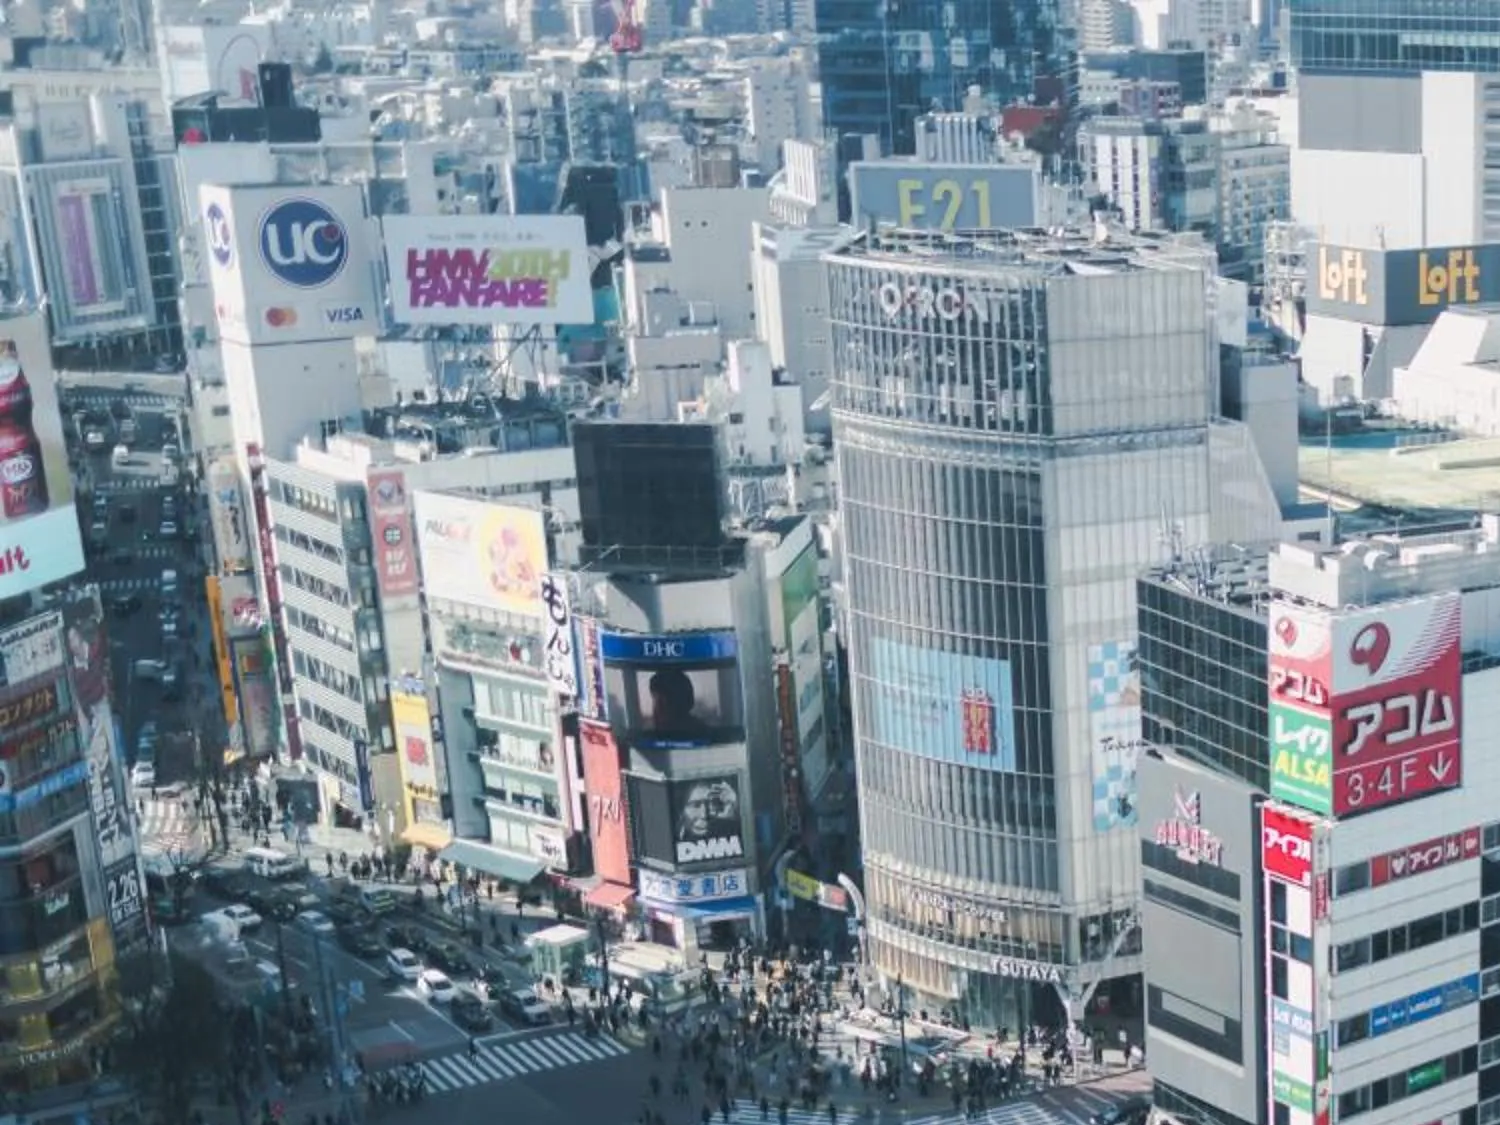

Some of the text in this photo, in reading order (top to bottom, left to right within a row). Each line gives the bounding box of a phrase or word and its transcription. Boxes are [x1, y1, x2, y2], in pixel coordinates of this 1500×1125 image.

[266, 220, 343, 265] UC
[407, 247, 491, 281] HMV
[326, 306, 365, 322] VISA
[642, 640, 684, 657] DHC
[1270, 666, 1330, 706] アコム
[1274, 714, 1331, 757] レイク
[1343, 688, 1456, 756] アコム
[1274, 754, 1330, 787] ALSA
[677, 839, 743, 863] DMM
[989, 956, 1063, 984] TSUTAYA
